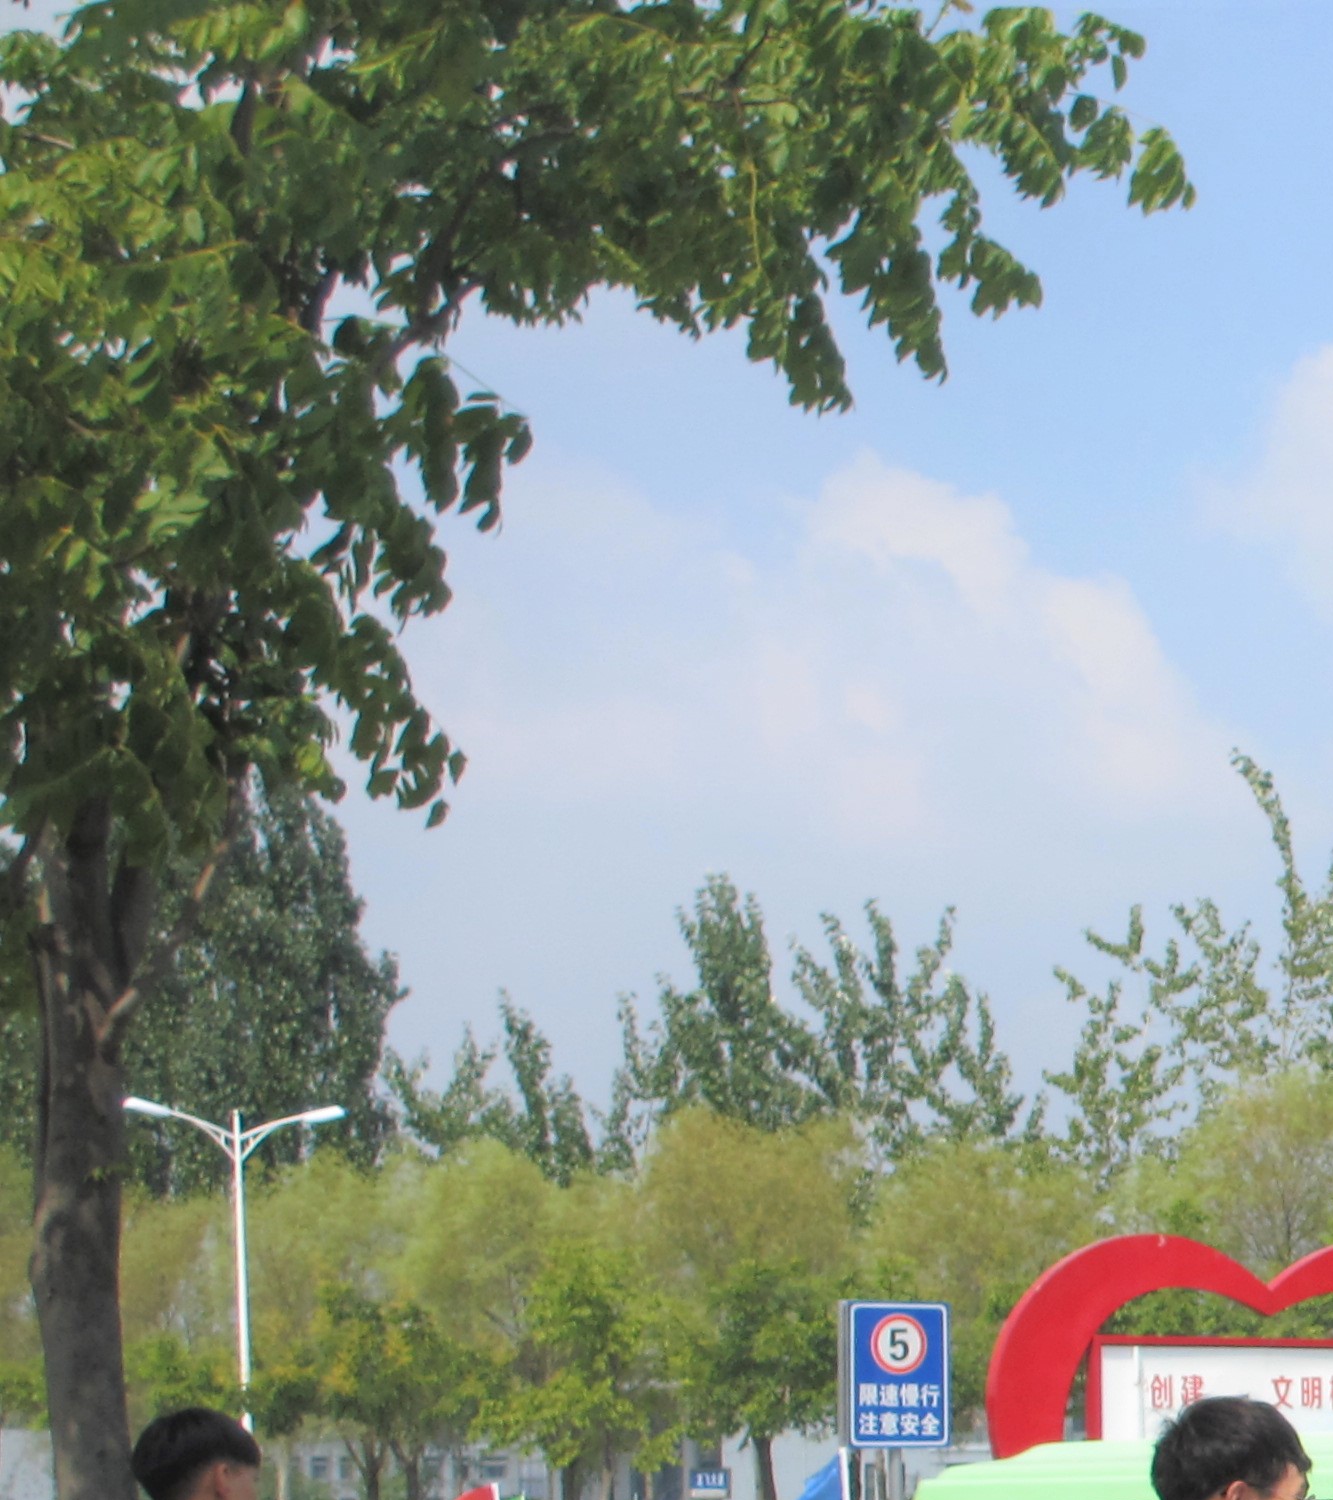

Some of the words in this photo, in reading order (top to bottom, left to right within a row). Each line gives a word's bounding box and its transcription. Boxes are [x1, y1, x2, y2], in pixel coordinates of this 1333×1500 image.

[889, 1328, 909, 1361] 5
[858, 1383, 939, 1408] 限速慢行
[1150, 1374, 1204, 1409] 创建
[858, 1412, 940, 1436] 注意安全
